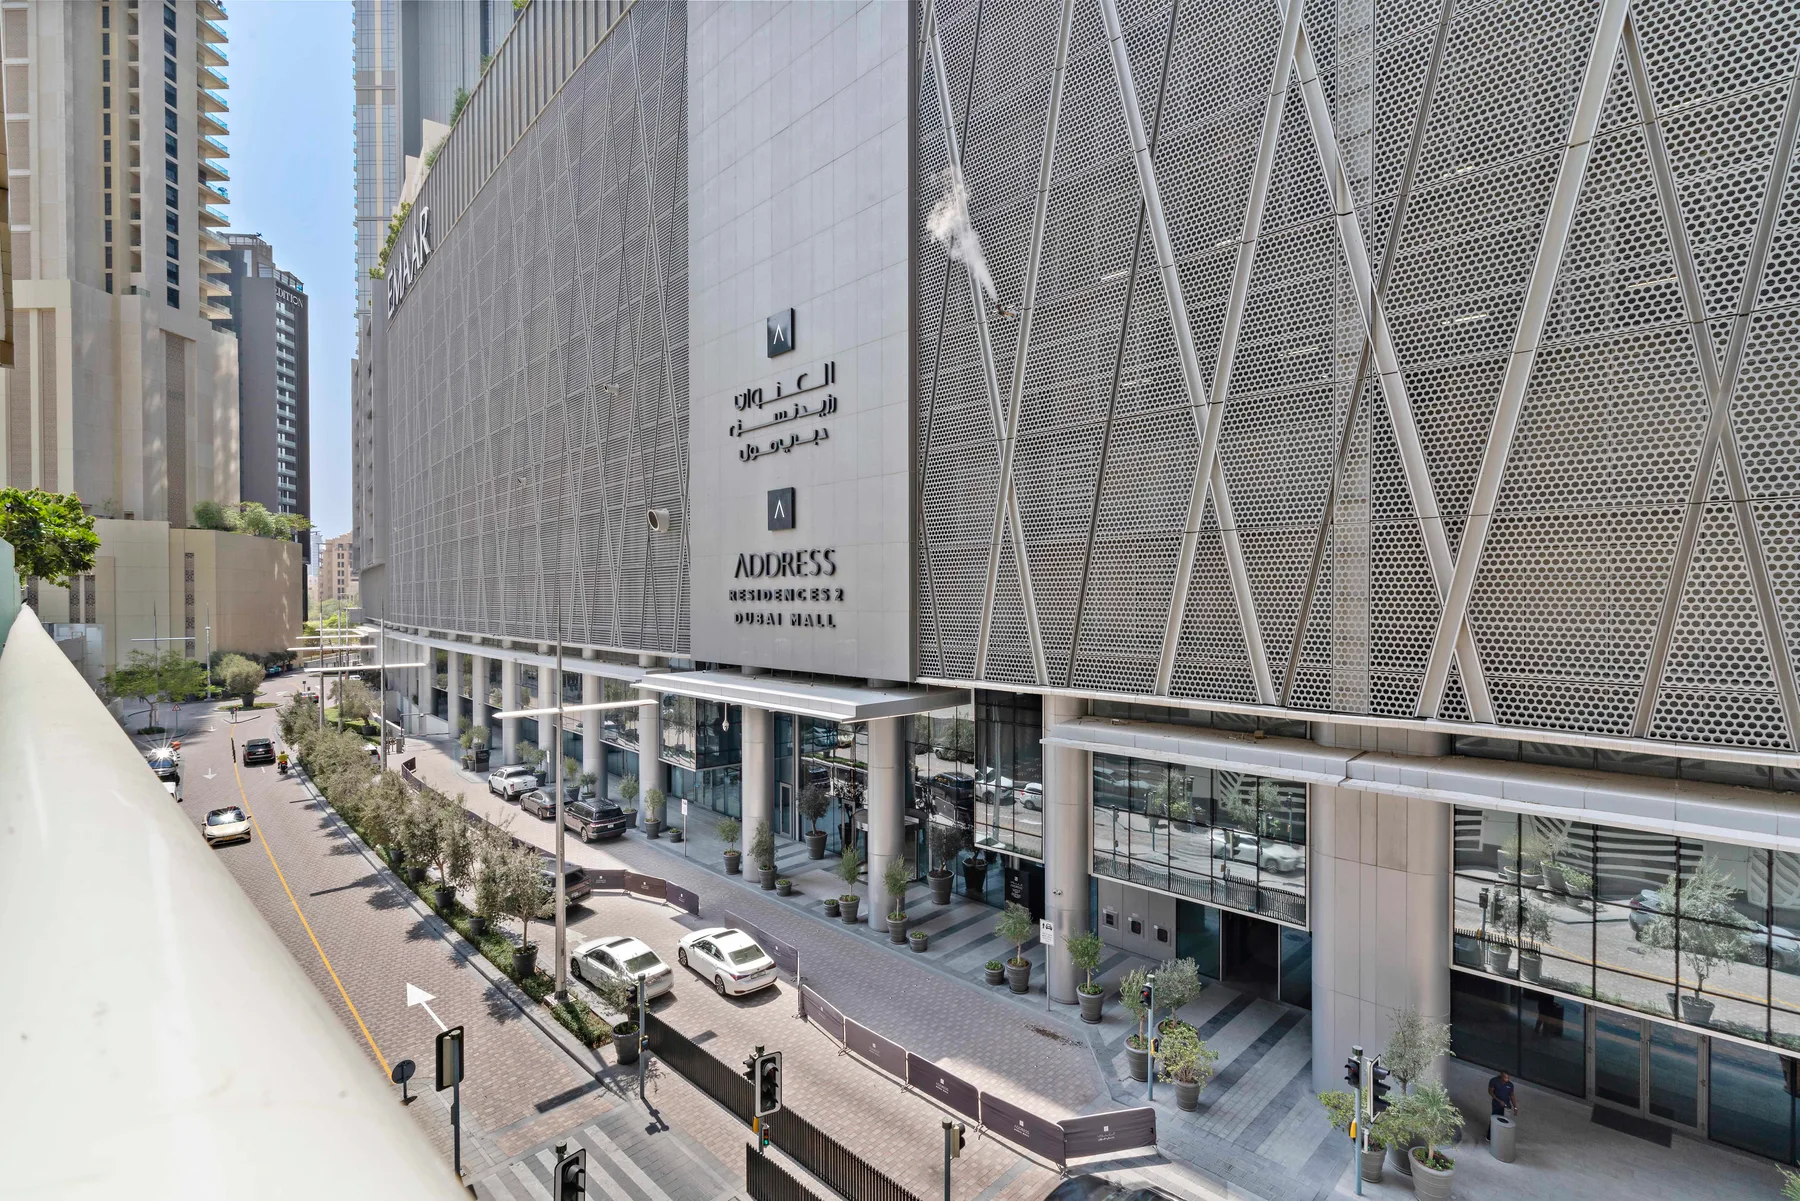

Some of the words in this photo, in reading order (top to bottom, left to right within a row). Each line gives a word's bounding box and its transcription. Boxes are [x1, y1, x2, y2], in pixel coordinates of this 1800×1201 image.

[387, 206, 432, 319] EMAAR
[734, 361, 836, 411] العنوان
[734, 547, 837, 579] ADDRESS
[728, 587, 831, 602] RESIDENCES
[834, 587, 845, 602] 2
[734, 612, 783, 626] DUBAI
[789, 613, 837, 628] MALL
